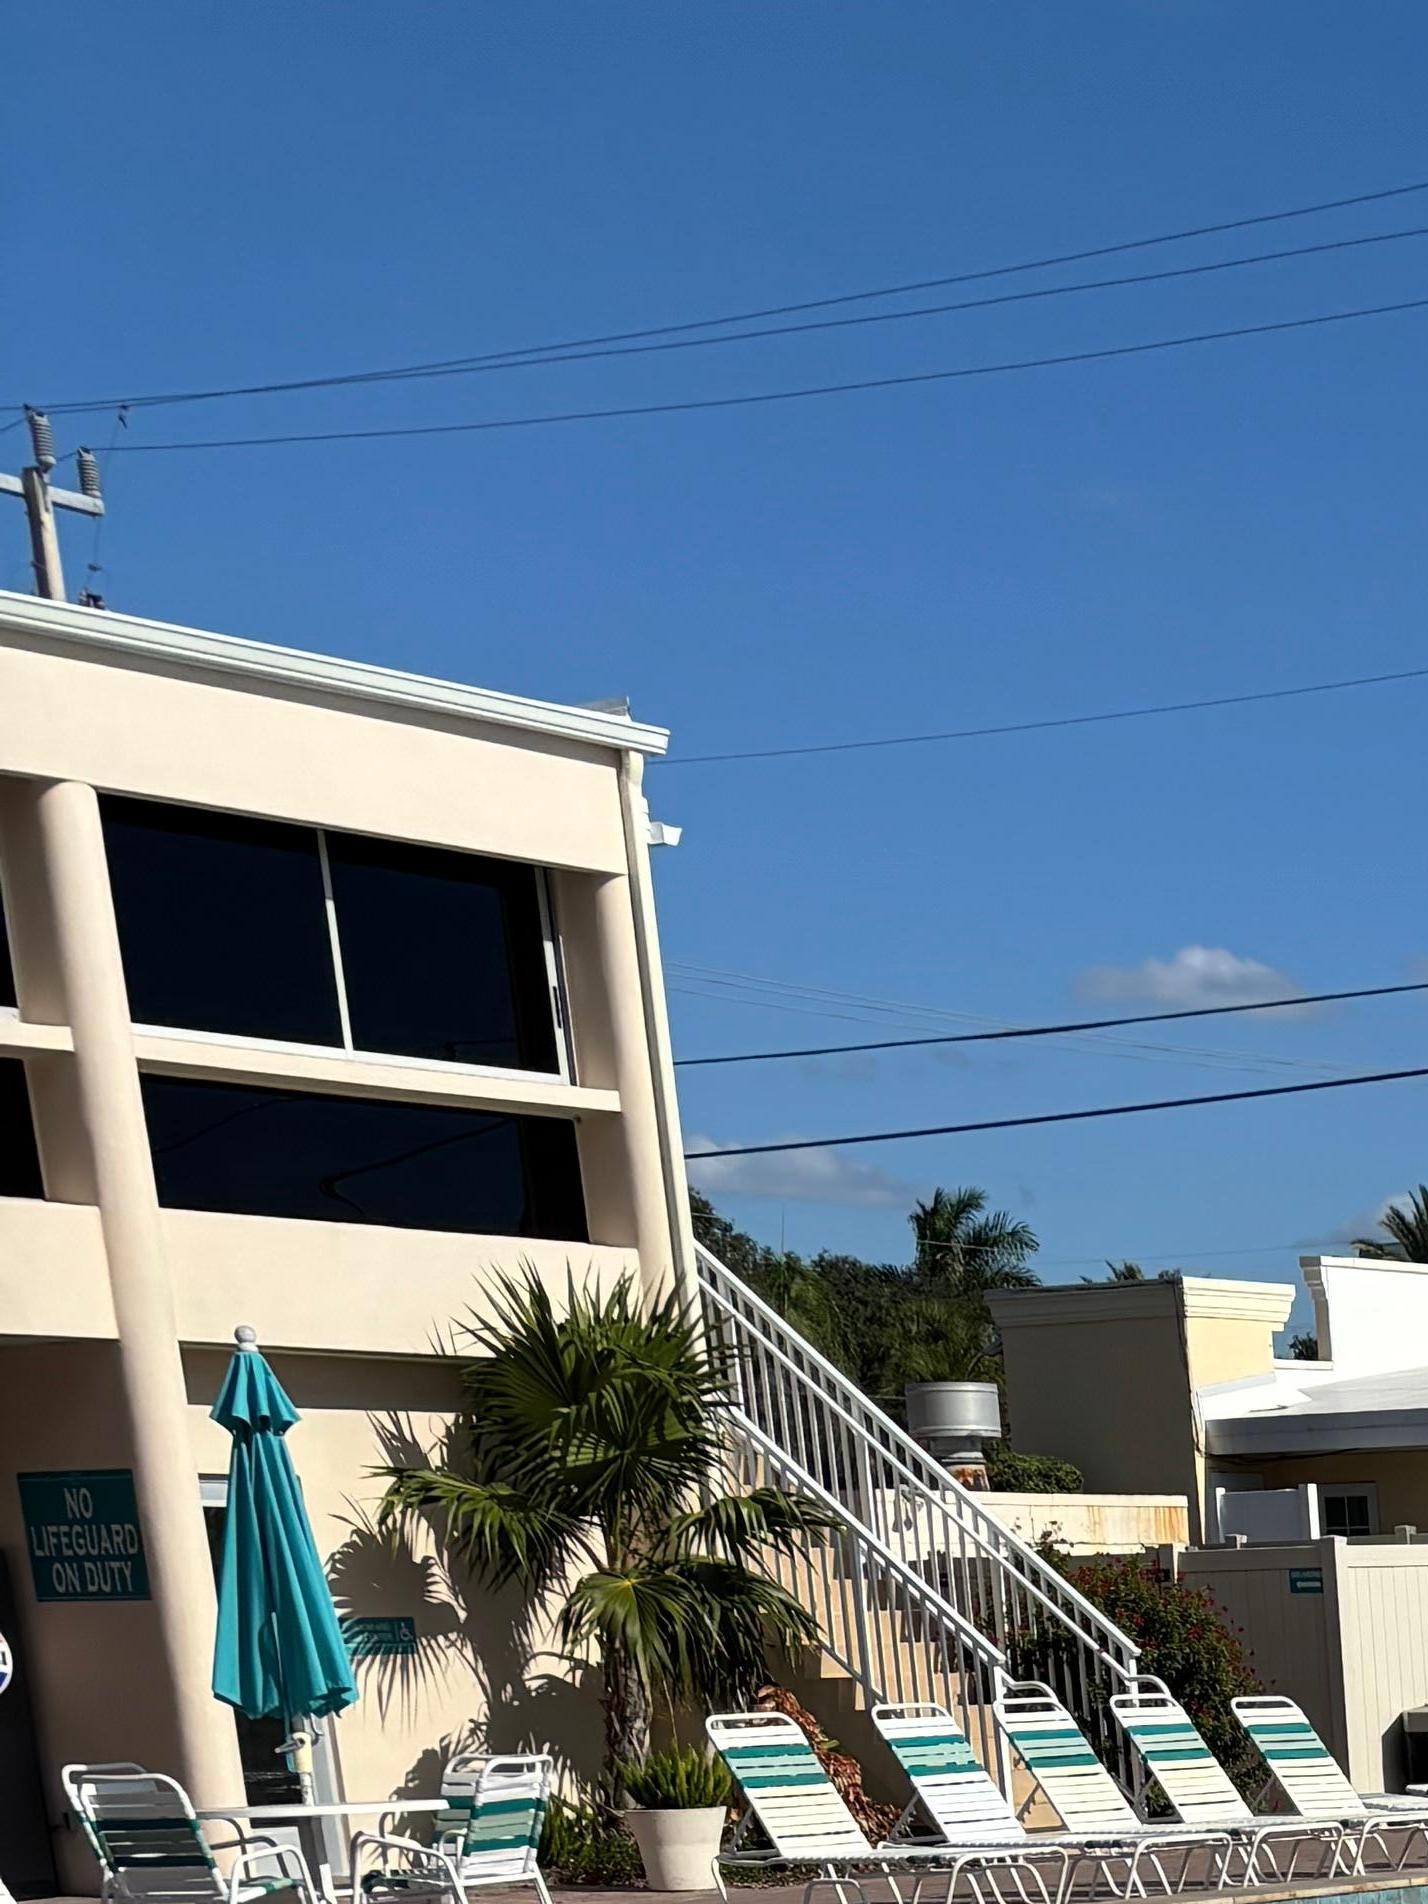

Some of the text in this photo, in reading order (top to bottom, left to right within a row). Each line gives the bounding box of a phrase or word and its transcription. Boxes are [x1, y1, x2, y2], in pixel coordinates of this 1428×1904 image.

[63, 1487, 94, 1520] NO
[30, 1523, 139, 1557] LIFEGUARD
[52, 1560, 133, 1594] ON DUTY
